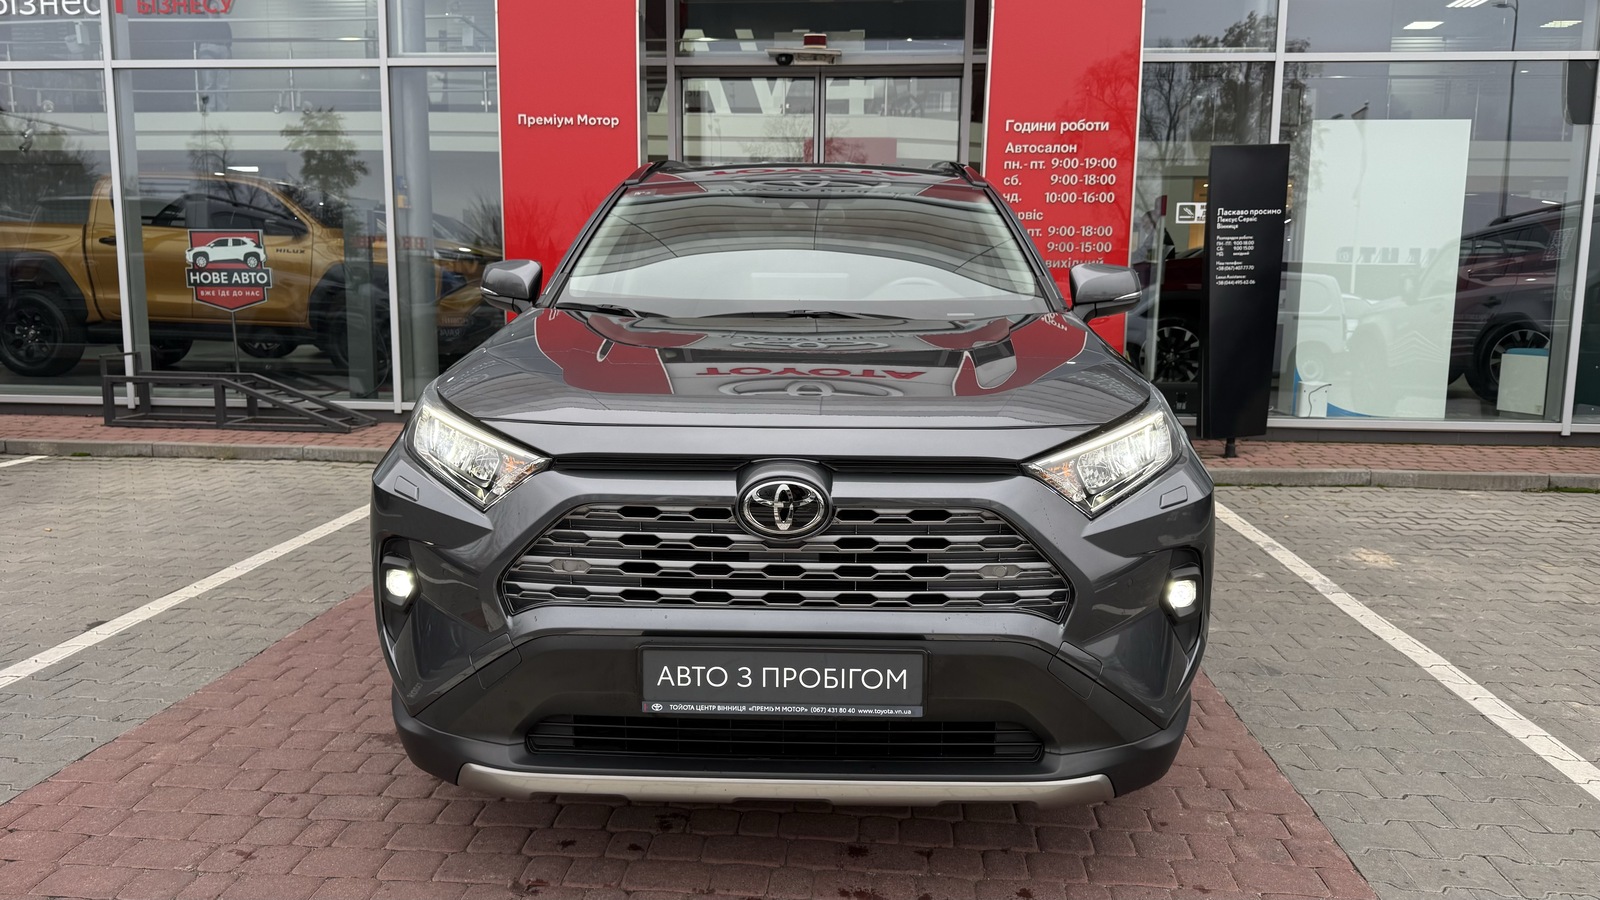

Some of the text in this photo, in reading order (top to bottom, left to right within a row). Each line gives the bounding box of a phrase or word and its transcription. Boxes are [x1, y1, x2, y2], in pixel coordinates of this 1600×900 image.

[517, 113, 620, 128] Преміум Мотор
[1005, 119, 1110, 134] Години роботи
[1004, 142, 1077, 154] Автосалон
[1051, 157, 1117, 169] 9:00-19:00
[1003, 174, 1117, 186] сб. 9:00-18:00
[1044, 191, 1115, 204] 10:00-16:00
[1014, 208, 1044, 221] рвіс
[1217, 207, 1282, 217] Ласкаво просимо
[1047, 225, 1113, 237] 9:00-18:00
[1046, 241, 1112, 253] 9:00-15:00
[190, 272, 268, 284] НОВЕ АВТО
[218, 289, 230, 297] ЇДЕ
[232, 290, 243, 298] ДО
[657, 665, 908, 690] АВТО З ПРОБІГОМ
[669, 703, 695, 711] ТОЙОТА
[695, 704, 717, 712] ЦЕНТР
[810, 706, 827, 714] (067)
[858, 708, 912, 716] www.toyota.vn.ua
